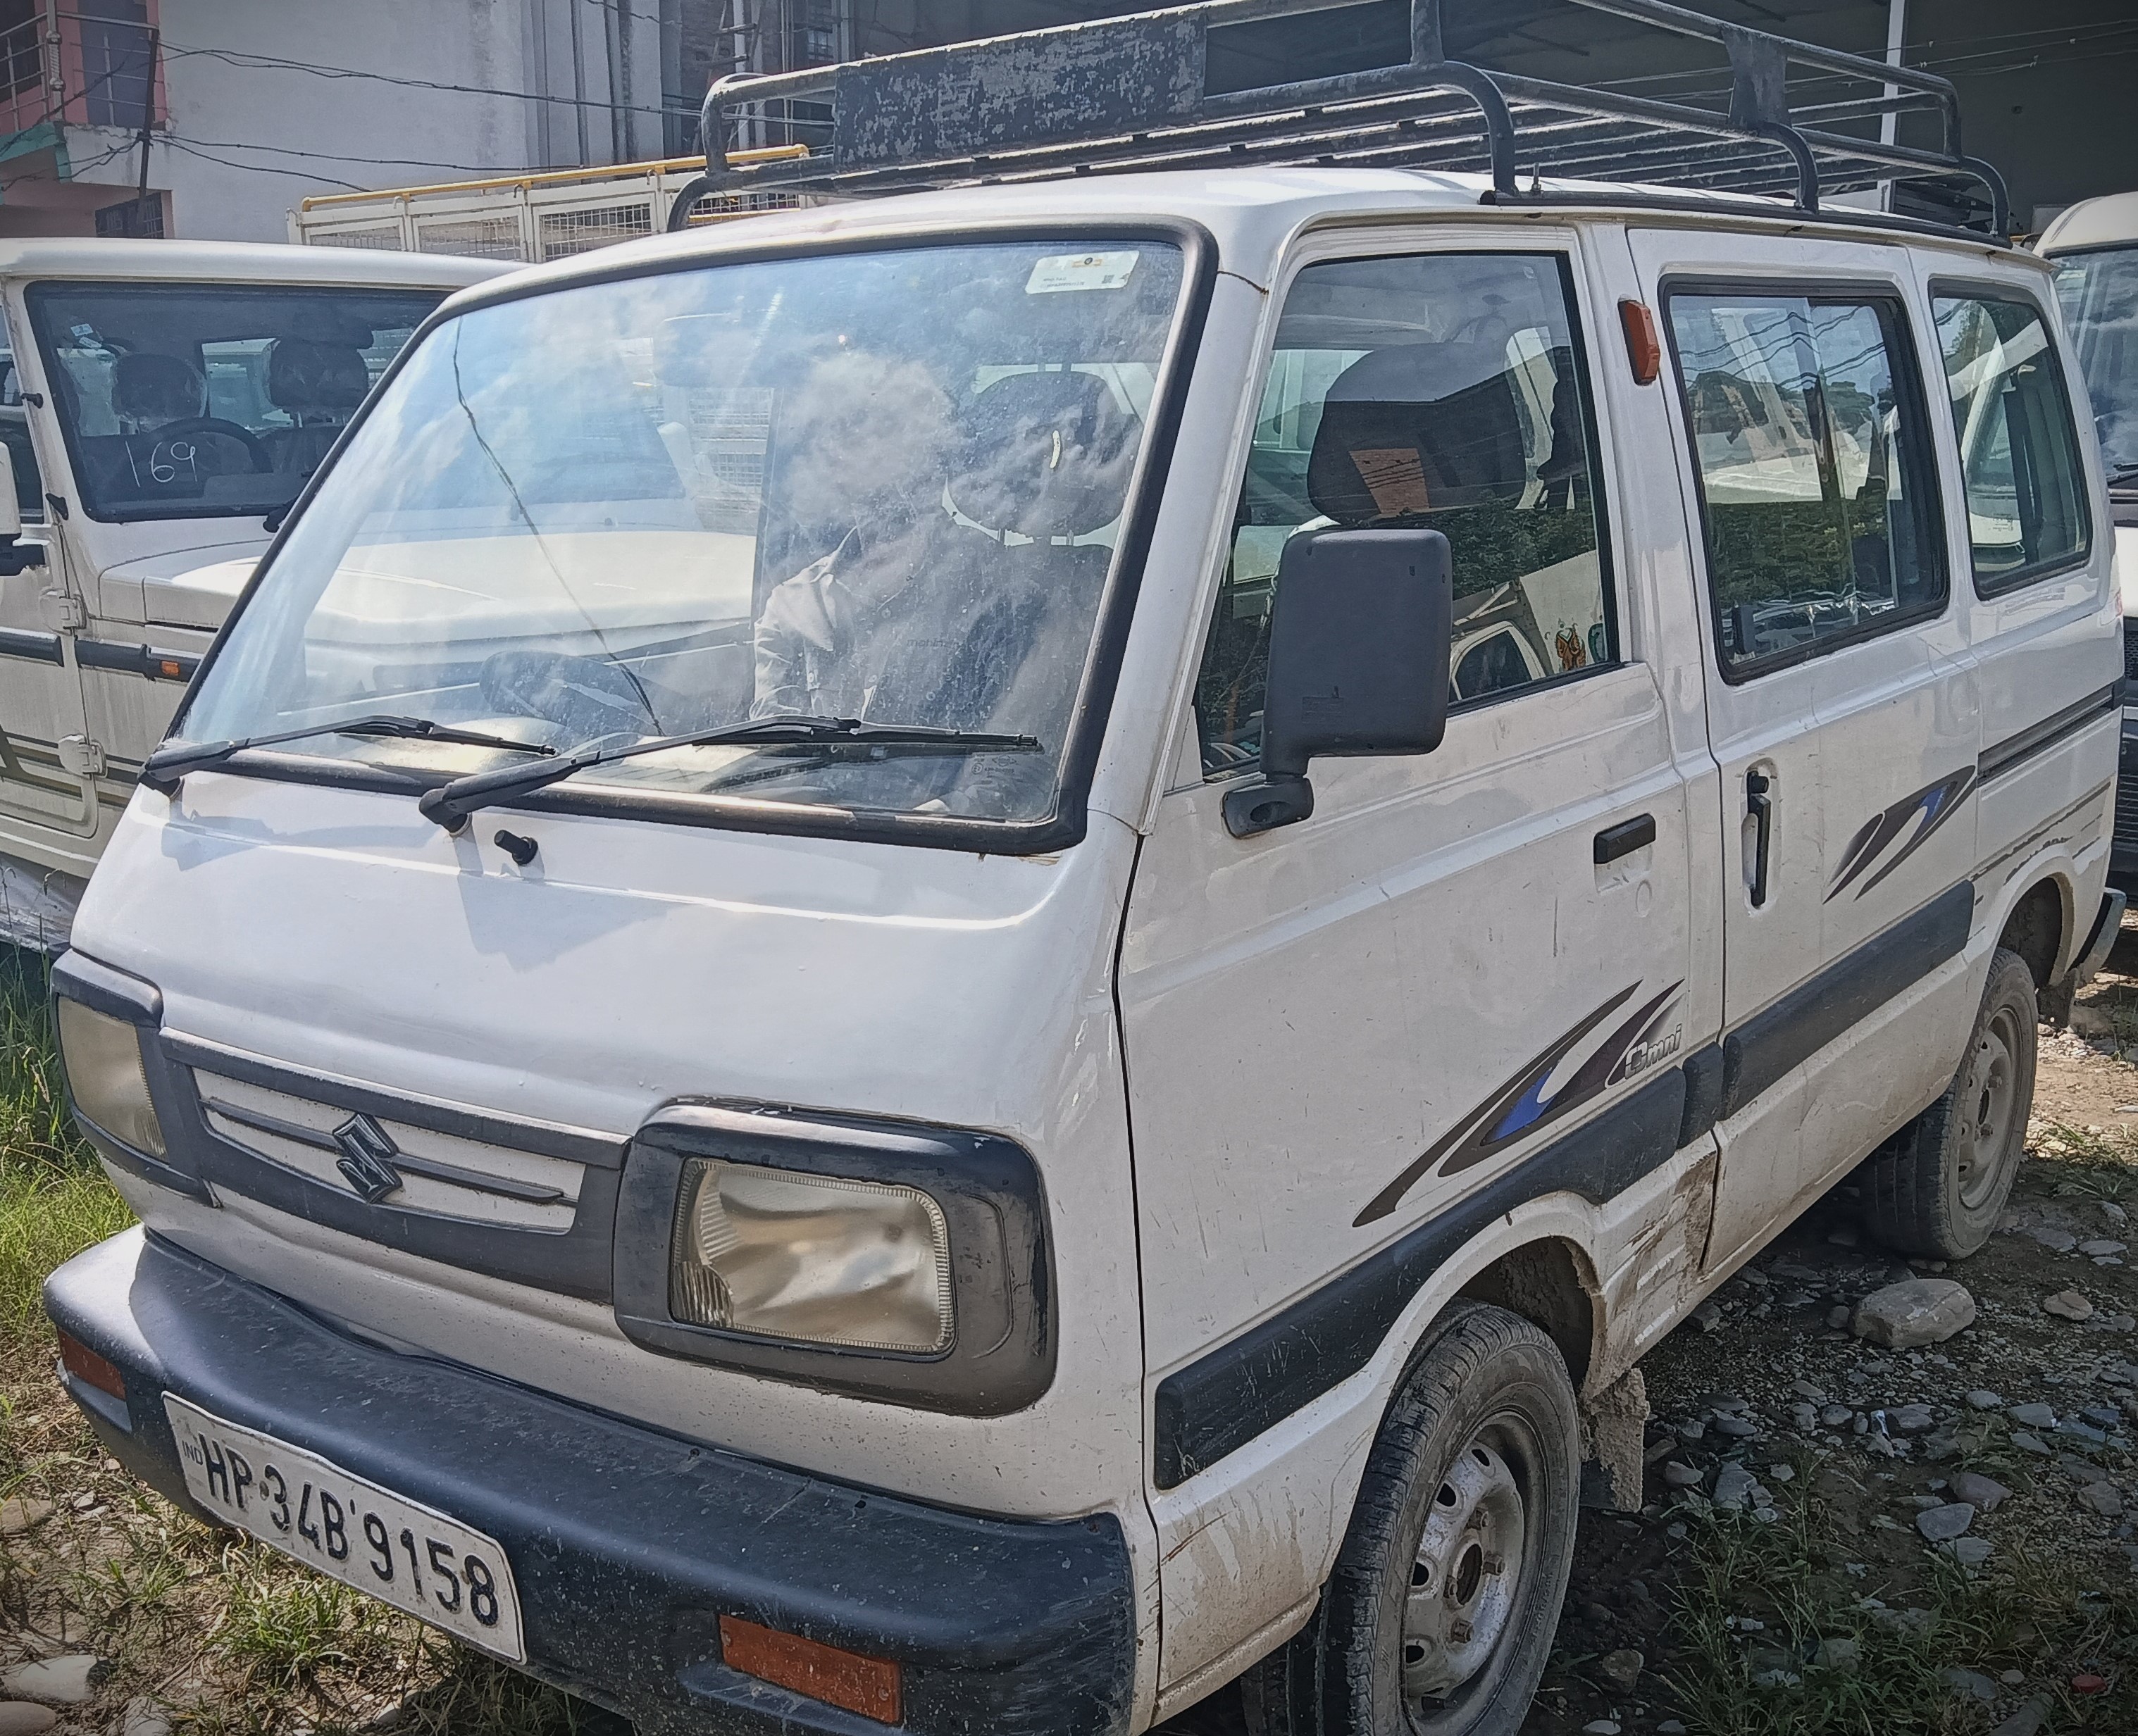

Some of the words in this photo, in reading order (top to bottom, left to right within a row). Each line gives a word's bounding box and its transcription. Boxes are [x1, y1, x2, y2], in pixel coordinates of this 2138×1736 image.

[125, 440, 198, 487] 169
[1624, 1023, 1682, 1080] Omni
[182, 1440, 203, 1465] IND
[363, 1512, 499, 1626] 9158
